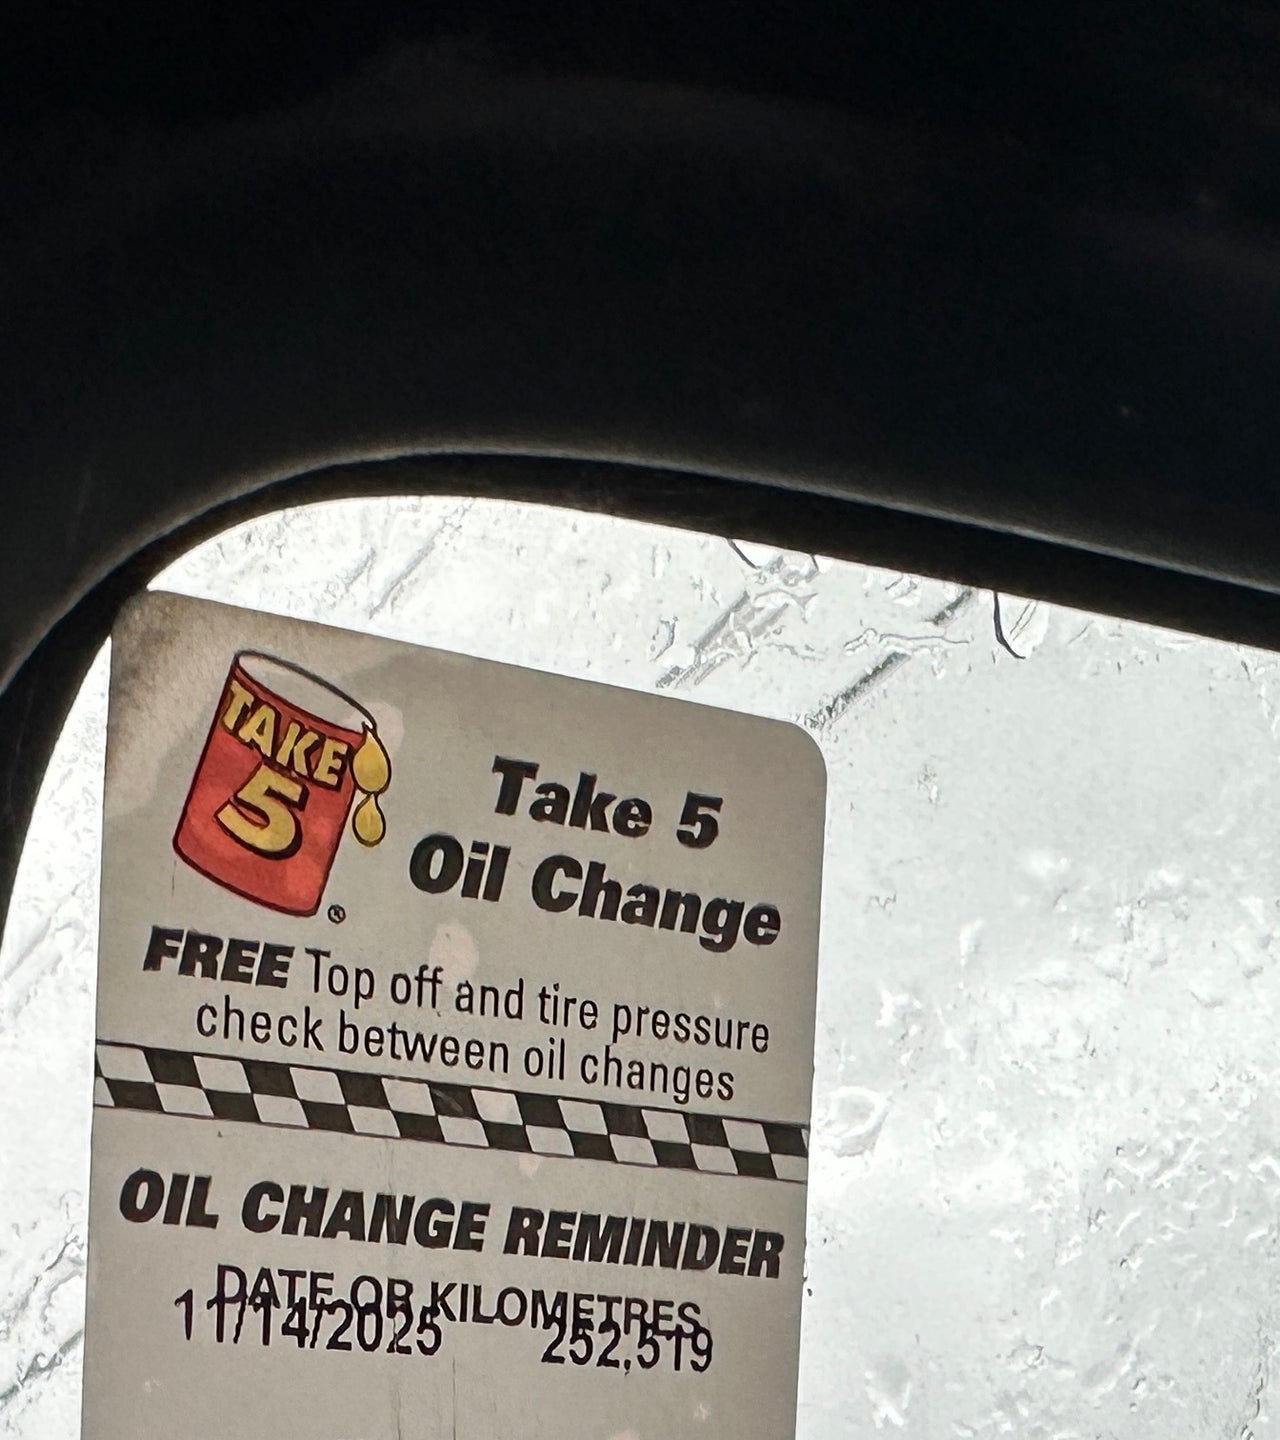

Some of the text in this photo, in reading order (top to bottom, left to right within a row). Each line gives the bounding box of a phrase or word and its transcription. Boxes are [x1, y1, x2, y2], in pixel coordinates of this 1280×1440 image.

[219, 681, 354, 789] TAKE
[215, 760, 309, 860] 5
[492, 756, 722, 849] Take 5
[409, 833, 782, 953] Oil Change
[142, 926, 770, 1053] FREE Top off and tire pressure
[196, 996, 735, 1104] check between oil changes
[119, 1169, 785, 1279] OIL CHANGE REMINDER
[216, 1264, 702, 1341] DATE OR KILOMETRES
[541, 1319, 713, 1375] 252,519
